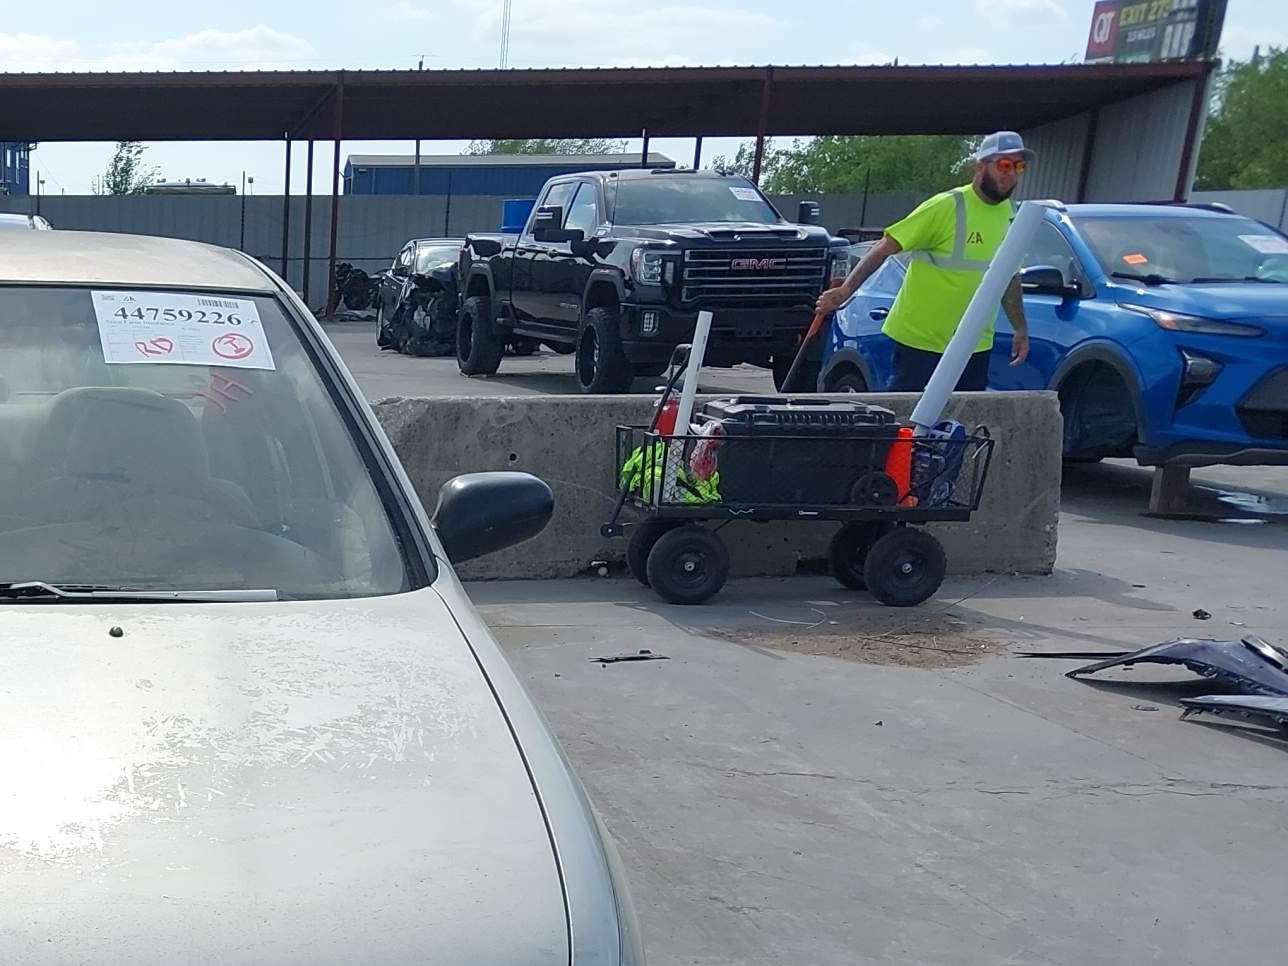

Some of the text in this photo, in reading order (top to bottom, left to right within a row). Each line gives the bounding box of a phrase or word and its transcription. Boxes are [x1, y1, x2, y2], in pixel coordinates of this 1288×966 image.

[1119, 3, 1147, 27] EXIT
[1093, 12, 1115, 44] QT
[730, 258, 787, 271] GMC
[114, 306, 242, 326] 44759226
